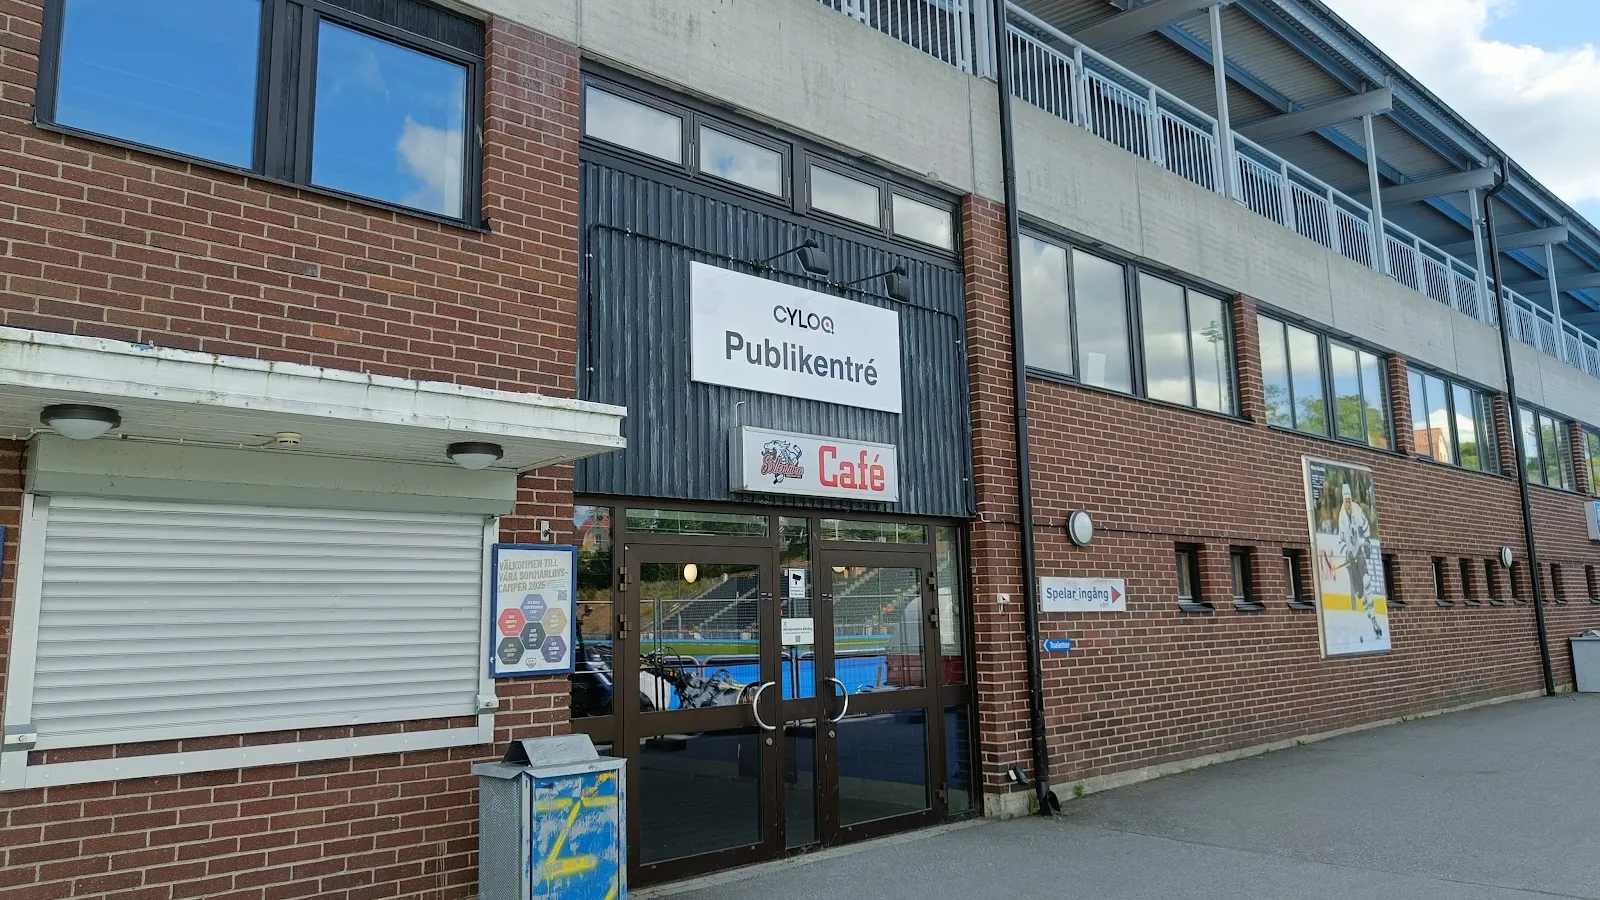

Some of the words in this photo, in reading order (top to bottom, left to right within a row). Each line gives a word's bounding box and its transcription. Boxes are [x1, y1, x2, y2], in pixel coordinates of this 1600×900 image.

[773, 305, 835, 335] CYLOQ
[725, 330, 878, 386] Publikentré
[818, 445, 885, 492] Café
[499, 559, 543, 571] VÄLKOMMEN
[544, 558, 559, 568] TILL
[498, 570, 518, 582] VÅRA
[498, 582, 527, 593] CAMPER
[528, 580, 547, 591] 2025
[1046, 587, 1076, 602] Spelar
[1078, 586, 1109, 602] ingång
